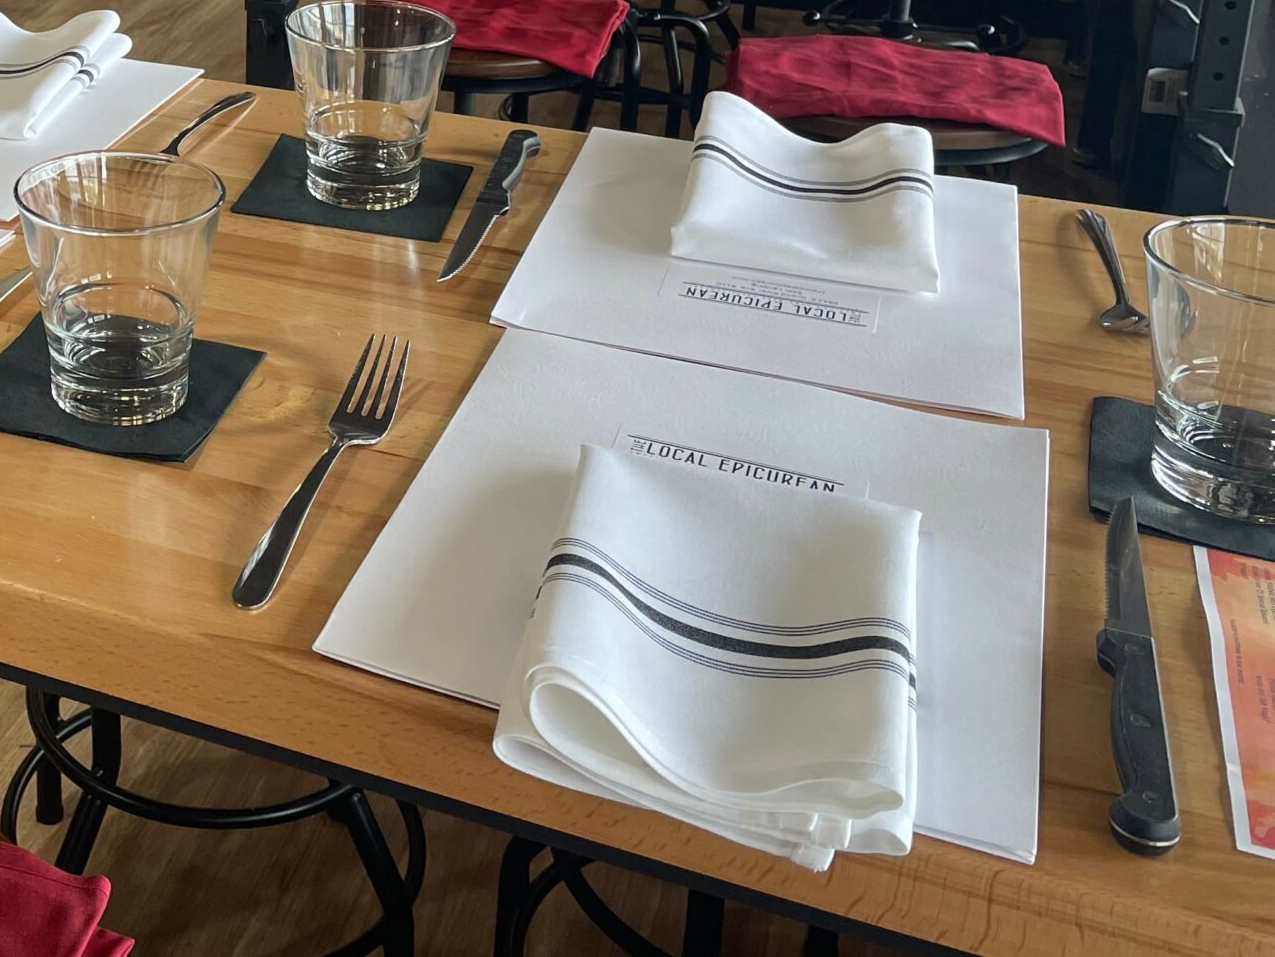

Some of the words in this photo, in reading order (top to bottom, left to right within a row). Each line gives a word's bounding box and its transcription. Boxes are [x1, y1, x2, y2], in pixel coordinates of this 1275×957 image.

[685, 286, 782, 311] EPICUREAN
[795, 305, 847, 322] LOCAL
[646, 442, 708, 468] LOCAL
